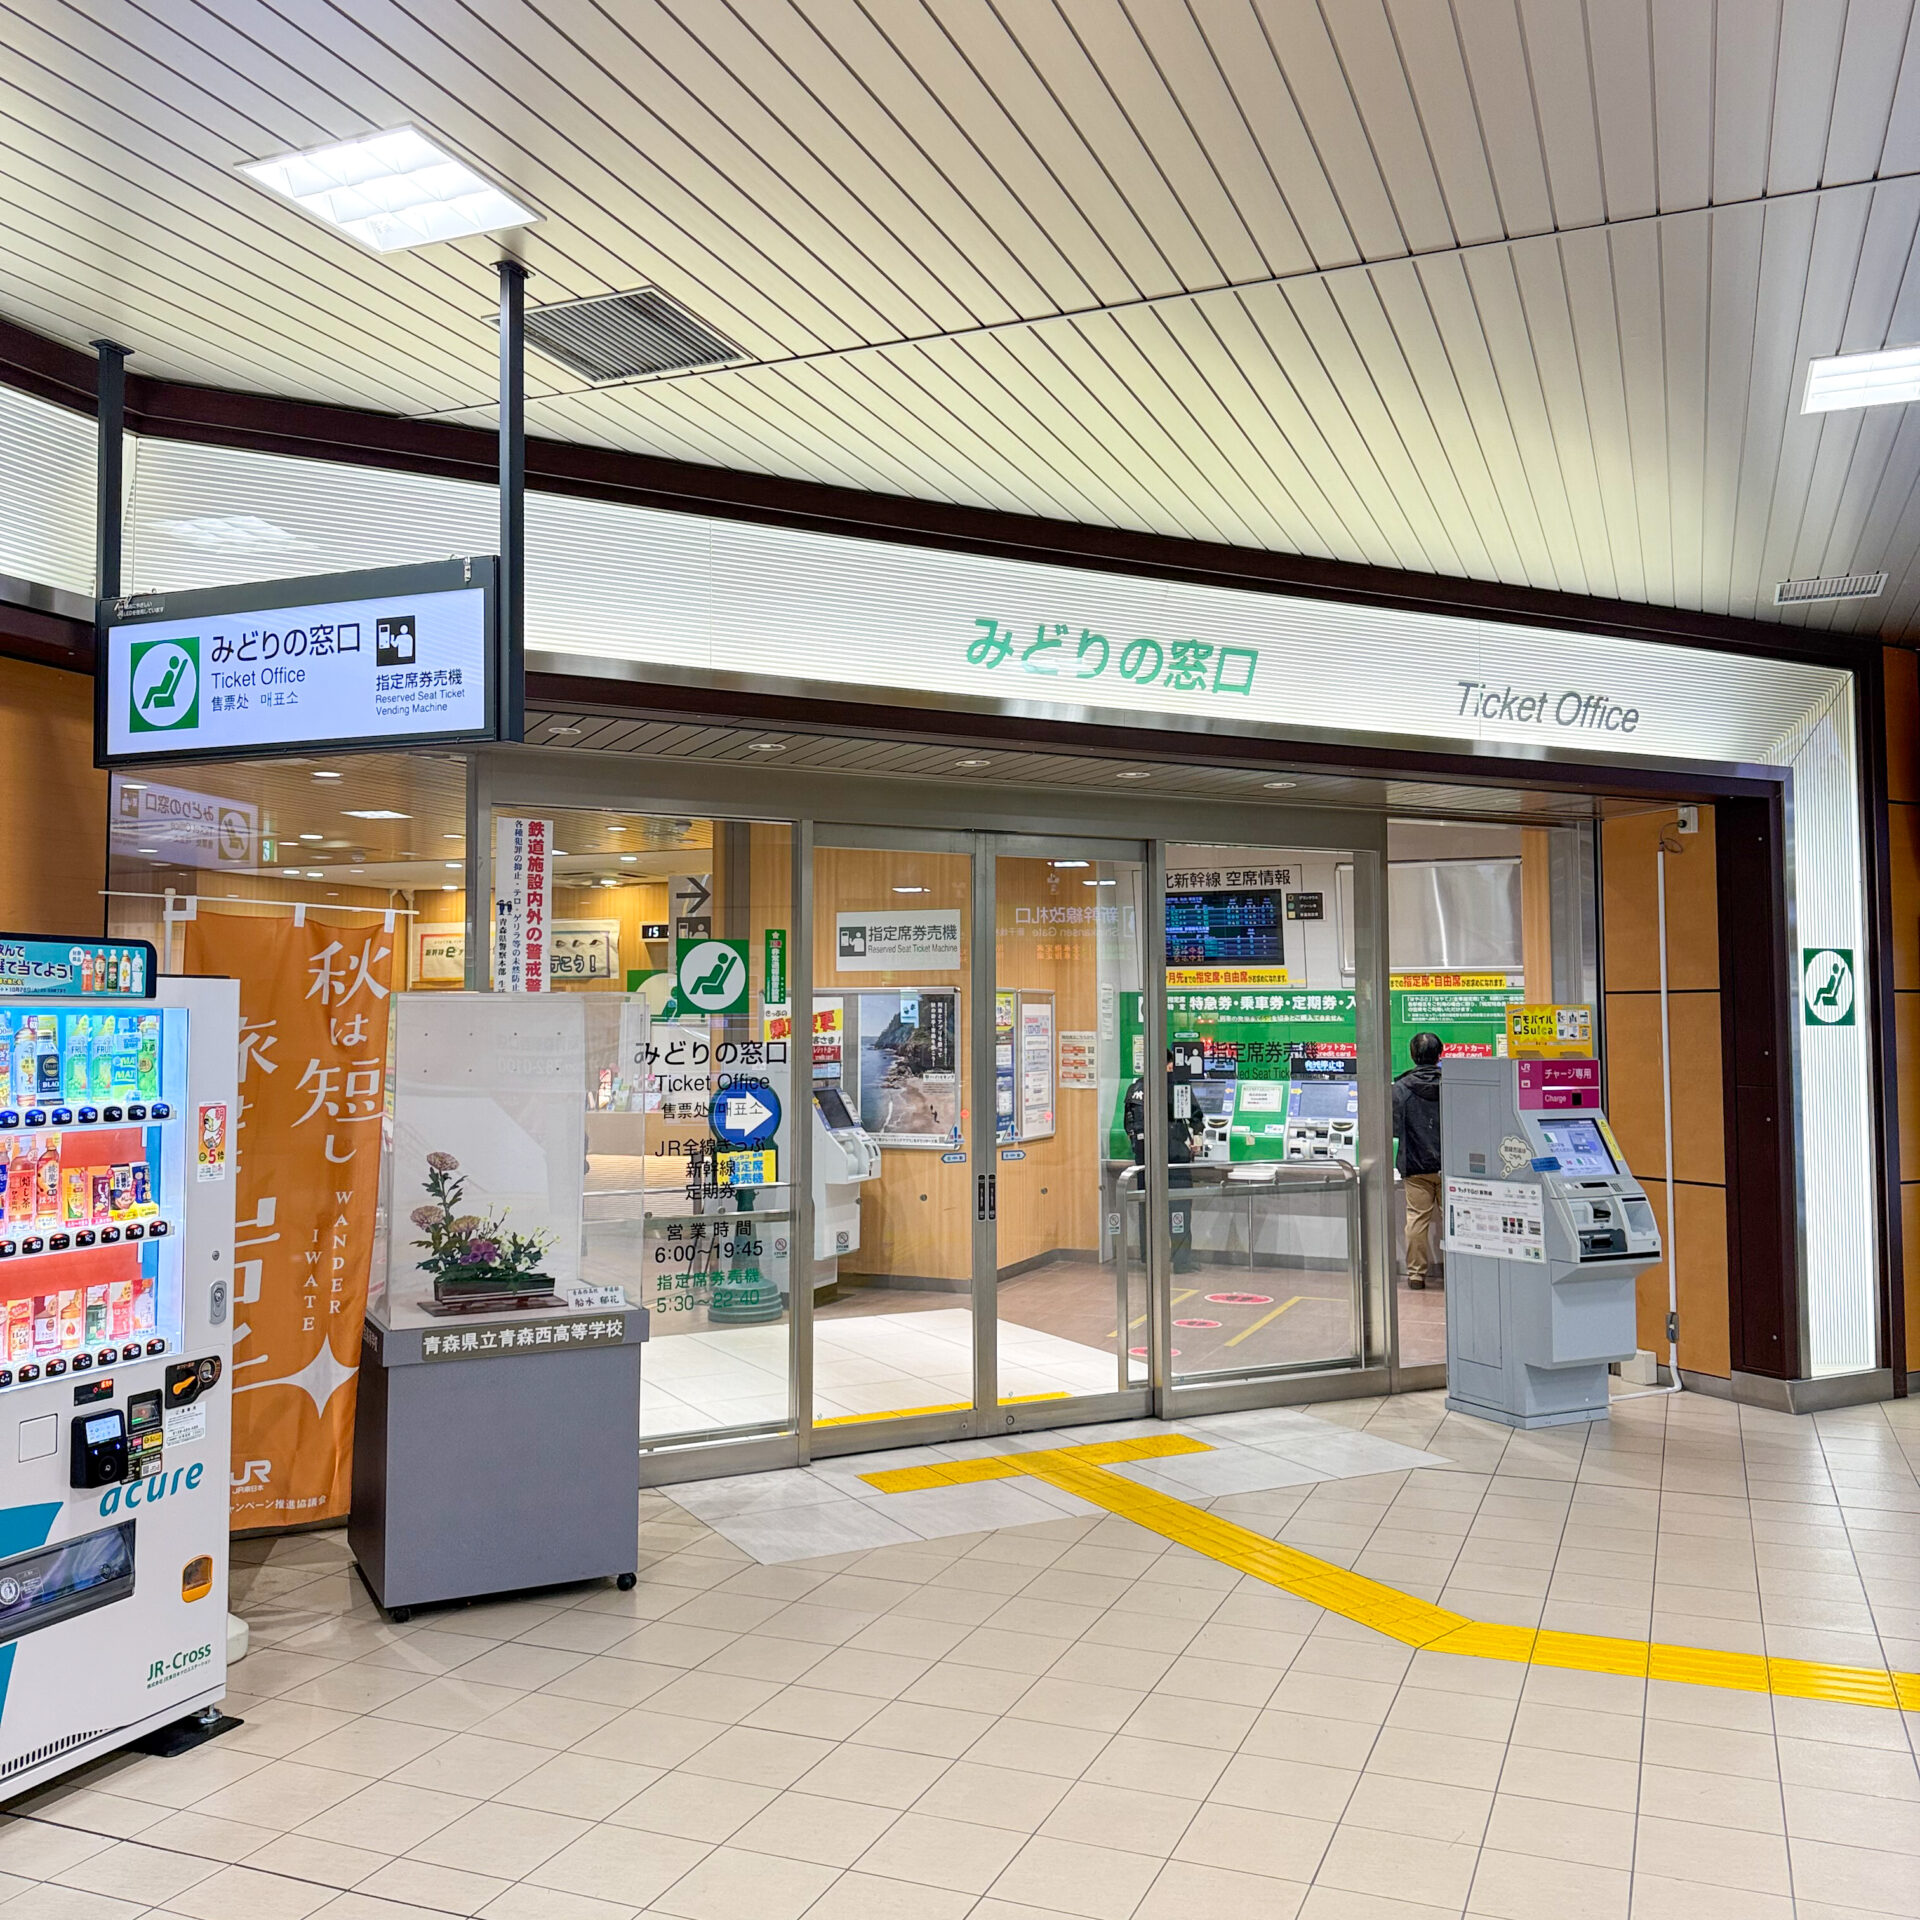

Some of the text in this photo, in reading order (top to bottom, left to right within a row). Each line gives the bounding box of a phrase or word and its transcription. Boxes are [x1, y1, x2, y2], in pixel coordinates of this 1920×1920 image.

[211, 622, 361, 664] みどりの窓口
[966, 618, 1259, 696] みどりの窓口
[211, 666, 306, 690] Ticket Office
[376, 668, 463, 692] 指定席券売機
[211, 693, 249, 712] 售票处
[260, 691, 299, 708] 매표소
[375, 688, 465, 704] Reserved Seat Ticket
[376, 702, 448, 717] Vending Machine
[1457, 682, 1640, 733] Ticket Office
[1226, 869, 1291, 887] 空席情報
[867, 924, 958, 942] 指定席券売機
[868, 943, 958, 953] Reserved Seat Ticket Machine
[1522, 1015, 1554, 1025] モバイル
[1523, 1025, 1554, 1035] Suica
[290, 938, 391, 1164] 秋は短し
[634, 1040, 788, 1067] みどりの窓口
[1210, 1041, 1320, 1063] 指定席券売機
[1256, 1067, 1272, 1080] Seat
[1520, 1063, 1531, 1071] JR
[1544, 1068, 1592, 1079] チャージ専用
[656, 1072, 770, 1092] Ticket Office
[717, 1101, 765, 1118] 매표소
[1544, 1095, 1567, 1104] Charge
[661, 1102, 710, 1120] 售票处
[654, 1136, 766, 1157] JR全線きっぷ
[685, 1159, 736, 1179] 新幹線
[685, 1182, 736, 1201] 定期券
[666, 1220, 752, 1241] 営業時間
[328, 1190, 354, 1314] WANDER
[302, 1228, 322, 1331] IWATE
[656, 1267, 760, 1292] 指定席券売機
[423, 1318, 624, 1356] 青森県立青森西高等学校
[230, 1459, 272, 1486] JR
[99, 1462, 204, 1518] acure
[231, 1484, 265, 1495] JR東日本
[146, 1643, 212, 1682] JR-Cross
